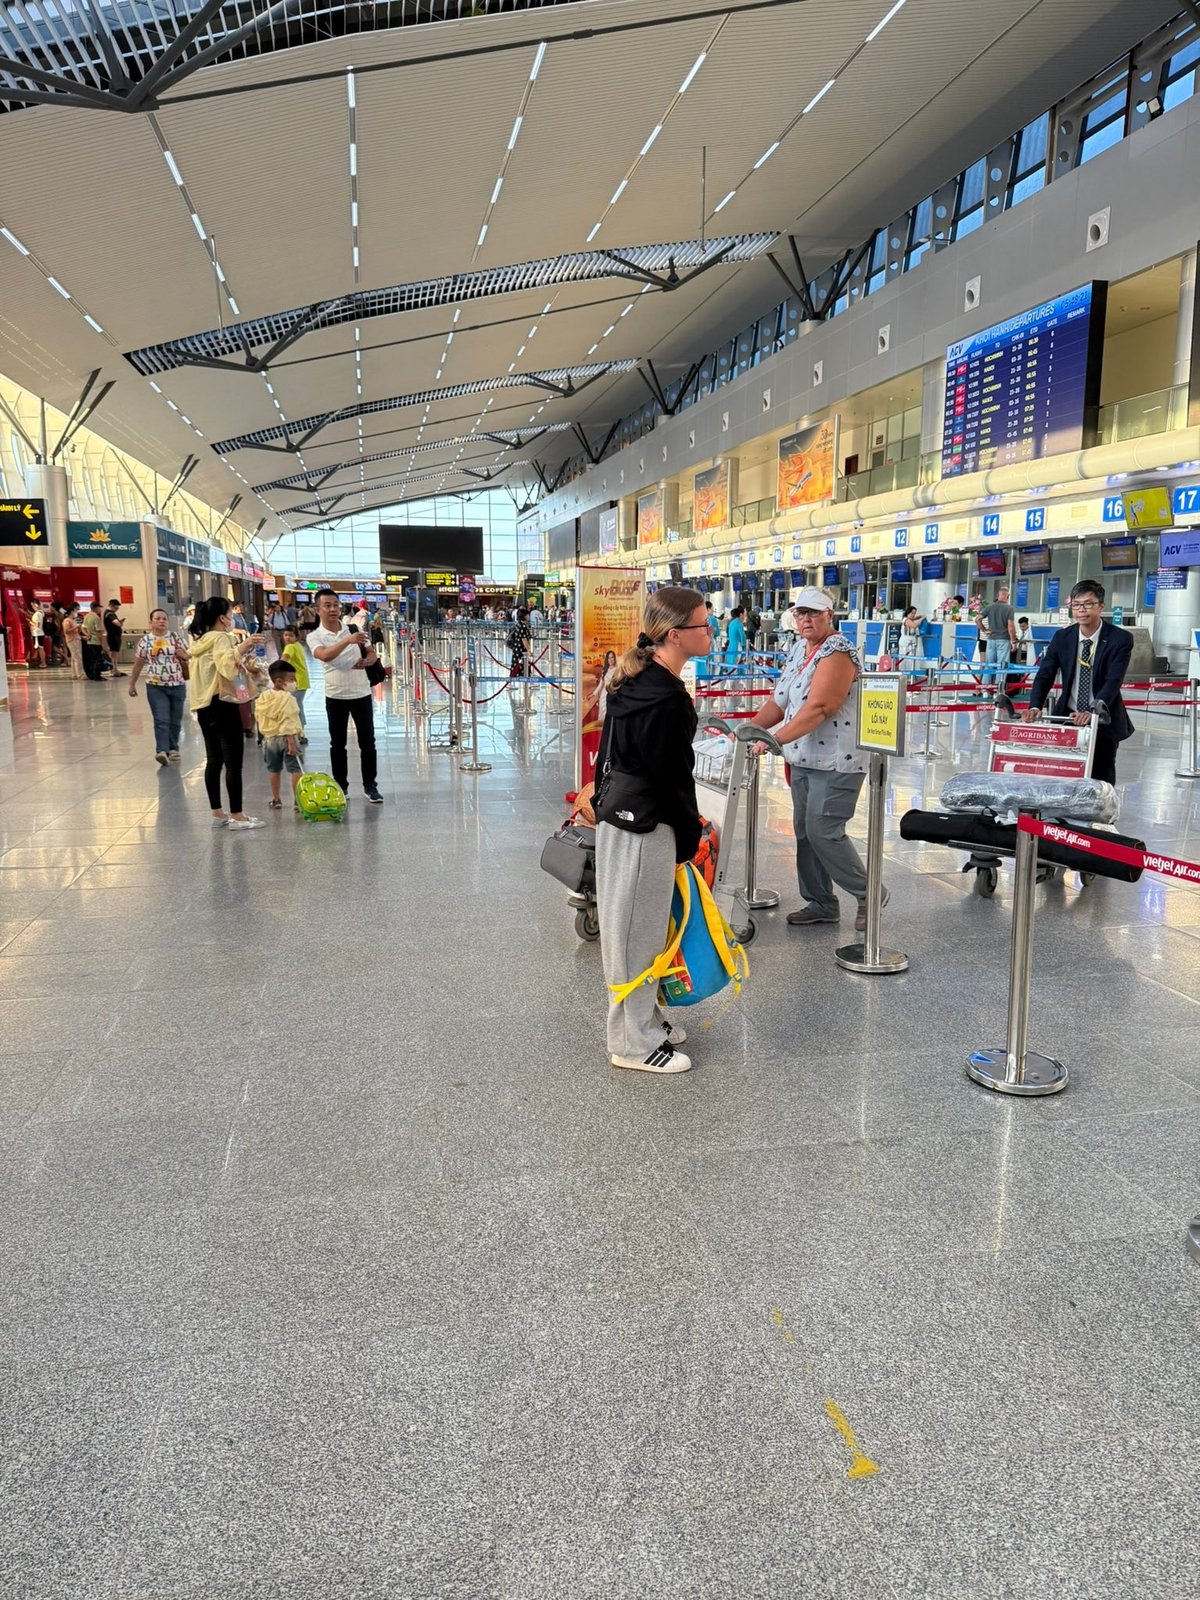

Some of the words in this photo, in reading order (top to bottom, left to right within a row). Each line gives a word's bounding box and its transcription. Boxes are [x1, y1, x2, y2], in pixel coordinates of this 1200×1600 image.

[1178, 490, 1198, 510] 17
[1106, 500, 1122, 518] 16
[986, 519, 998, 533] 14
[1028, 512, 1042, 528] 15
[896, 532, 906, 545] 12
[927, 526, 937, 540] 13
[827, 542, 835, 554] 10
[852, 539, 860, 550] 11
[1164, 546, 1182, 555] ACV
[868, 698, 883, 710] KHÔNG
[884, 699, 893, 710] VÀO
[1018, 731, 1057, 740] AGRIBANK
